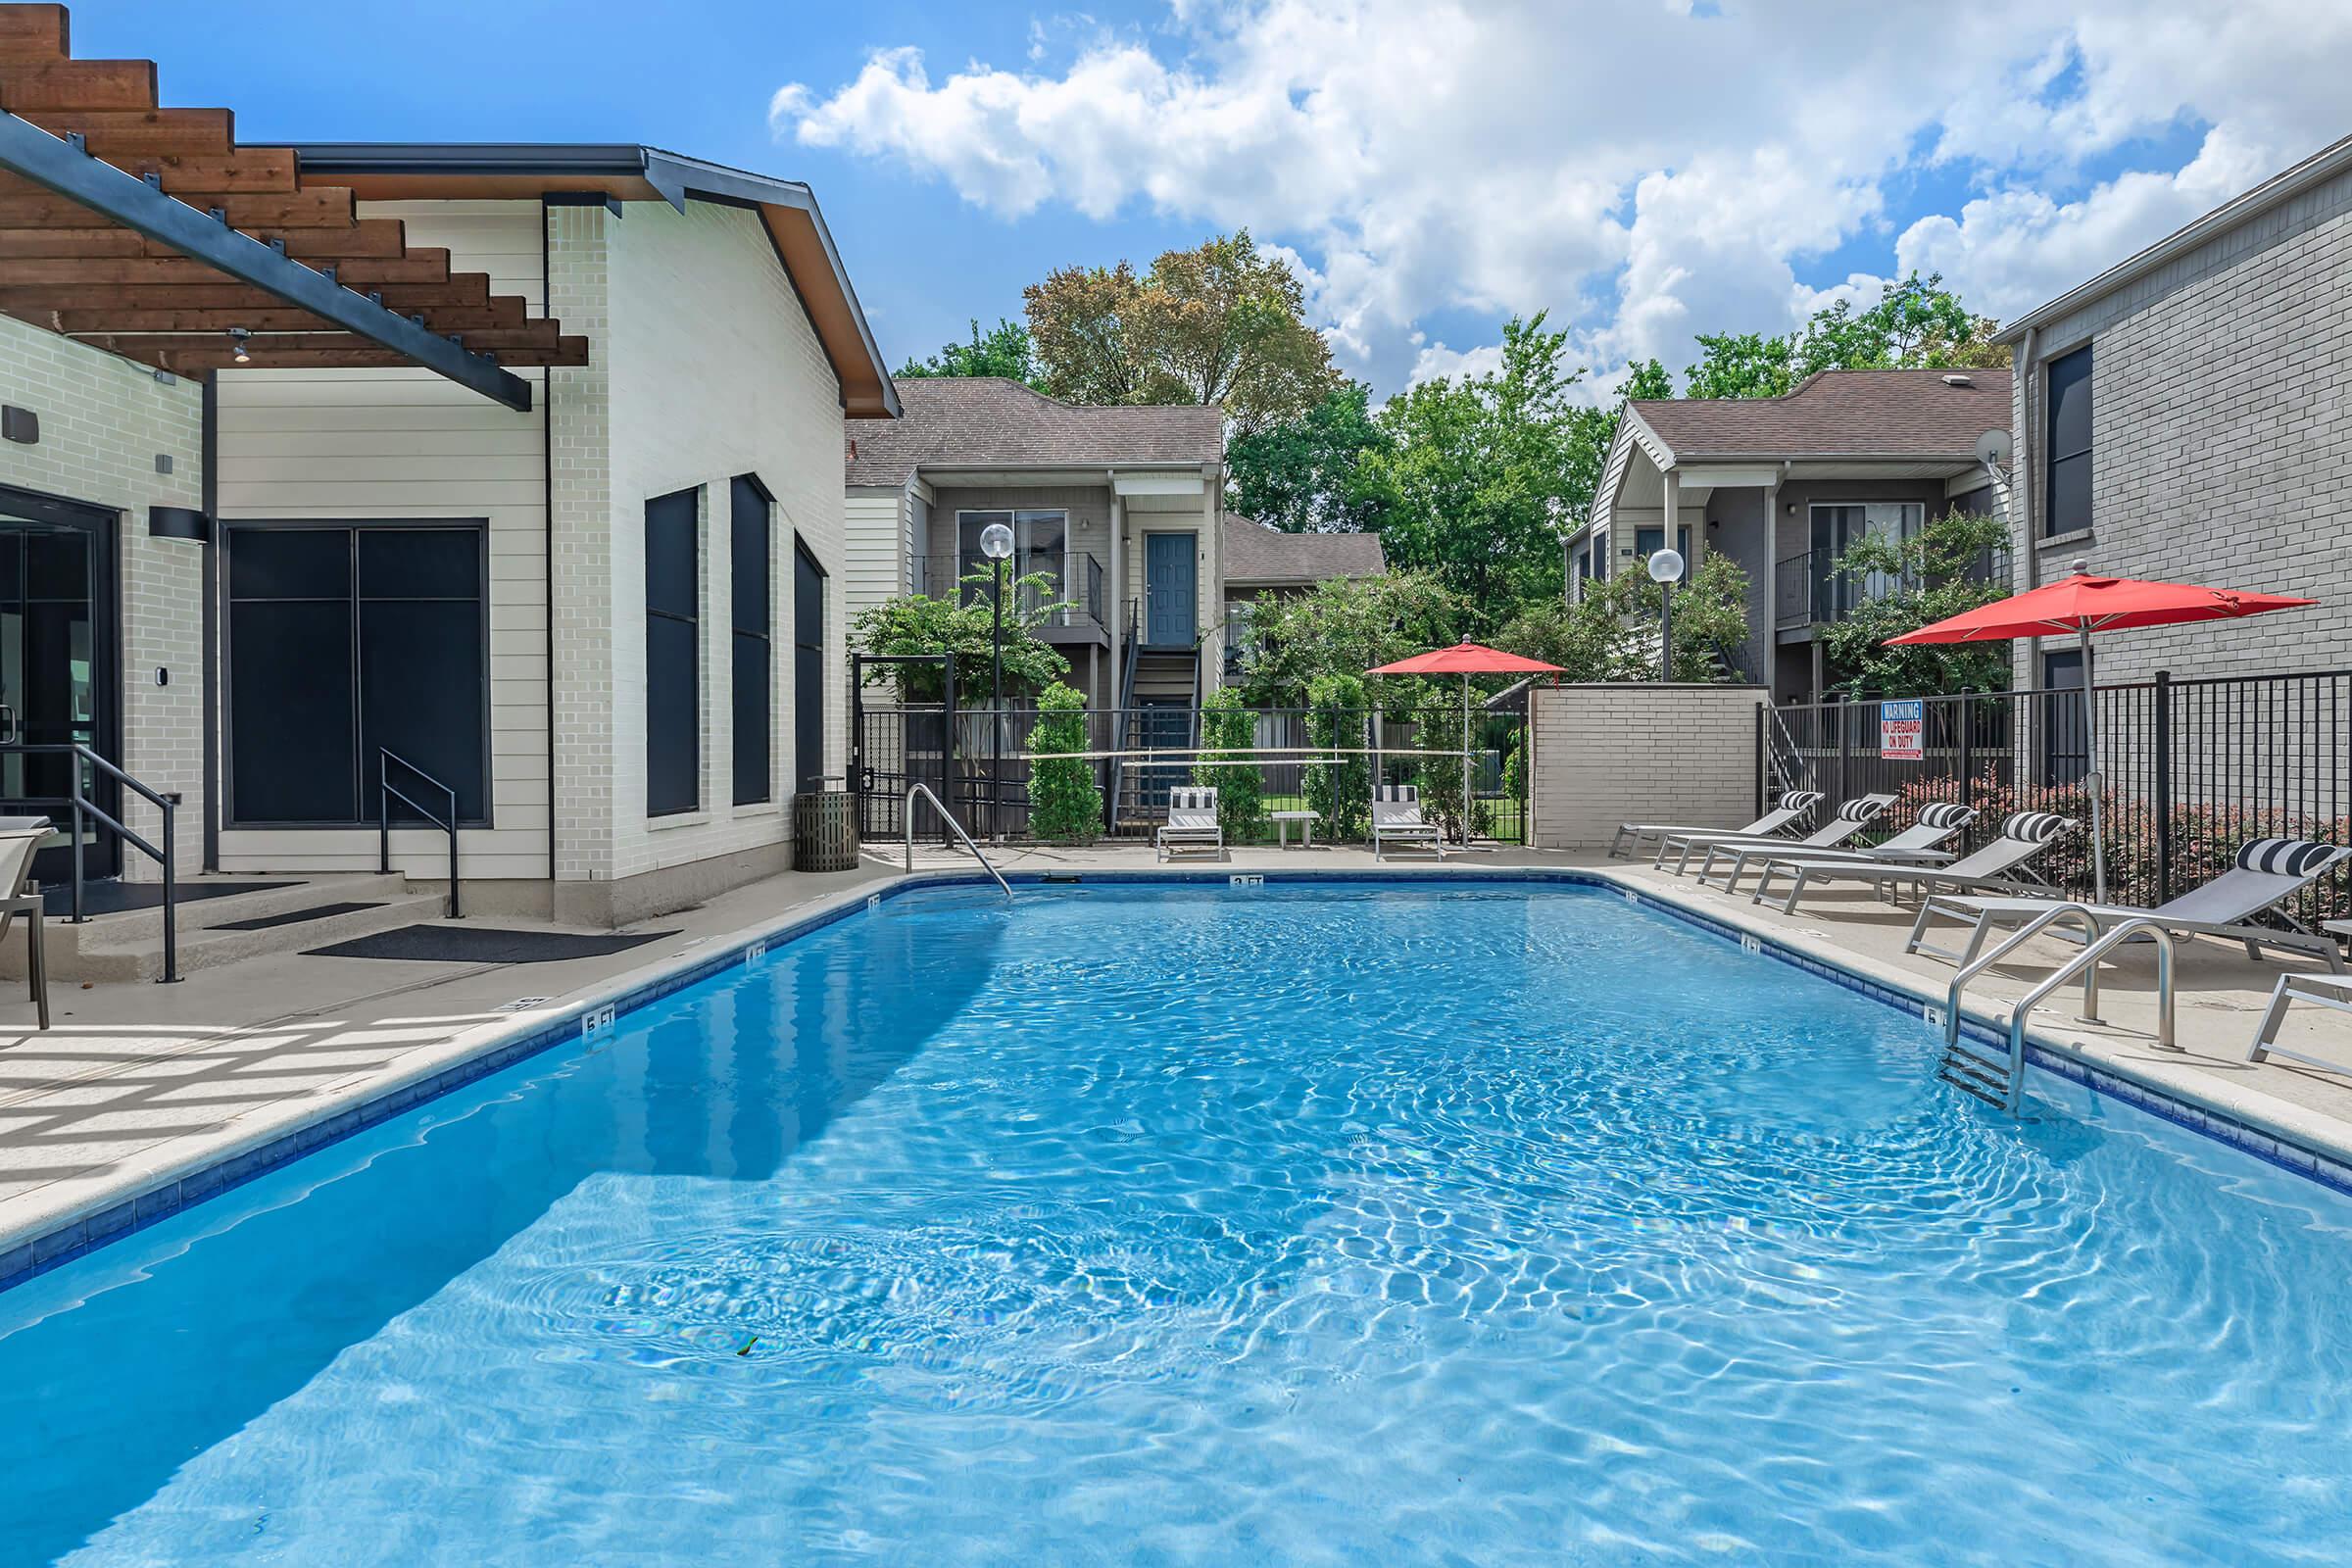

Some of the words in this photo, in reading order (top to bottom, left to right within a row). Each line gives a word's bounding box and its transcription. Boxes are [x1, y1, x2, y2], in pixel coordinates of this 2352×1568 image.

[1884, 703, 1920, 719] WARNING
[1883, 720, 1888, 733] NO
[1890, 720, 1921, 733] LIFEGUARD
[1888, 735, 1896, 748] ON
[1897, 735, 1914, 748] DUTY
[1248, 877, 1262, 886] FT
[587, 1015, 596, 1032] 5
[600, 1007, 613, 1026] FT
[1928, 1007, 1936, 1024] 5
